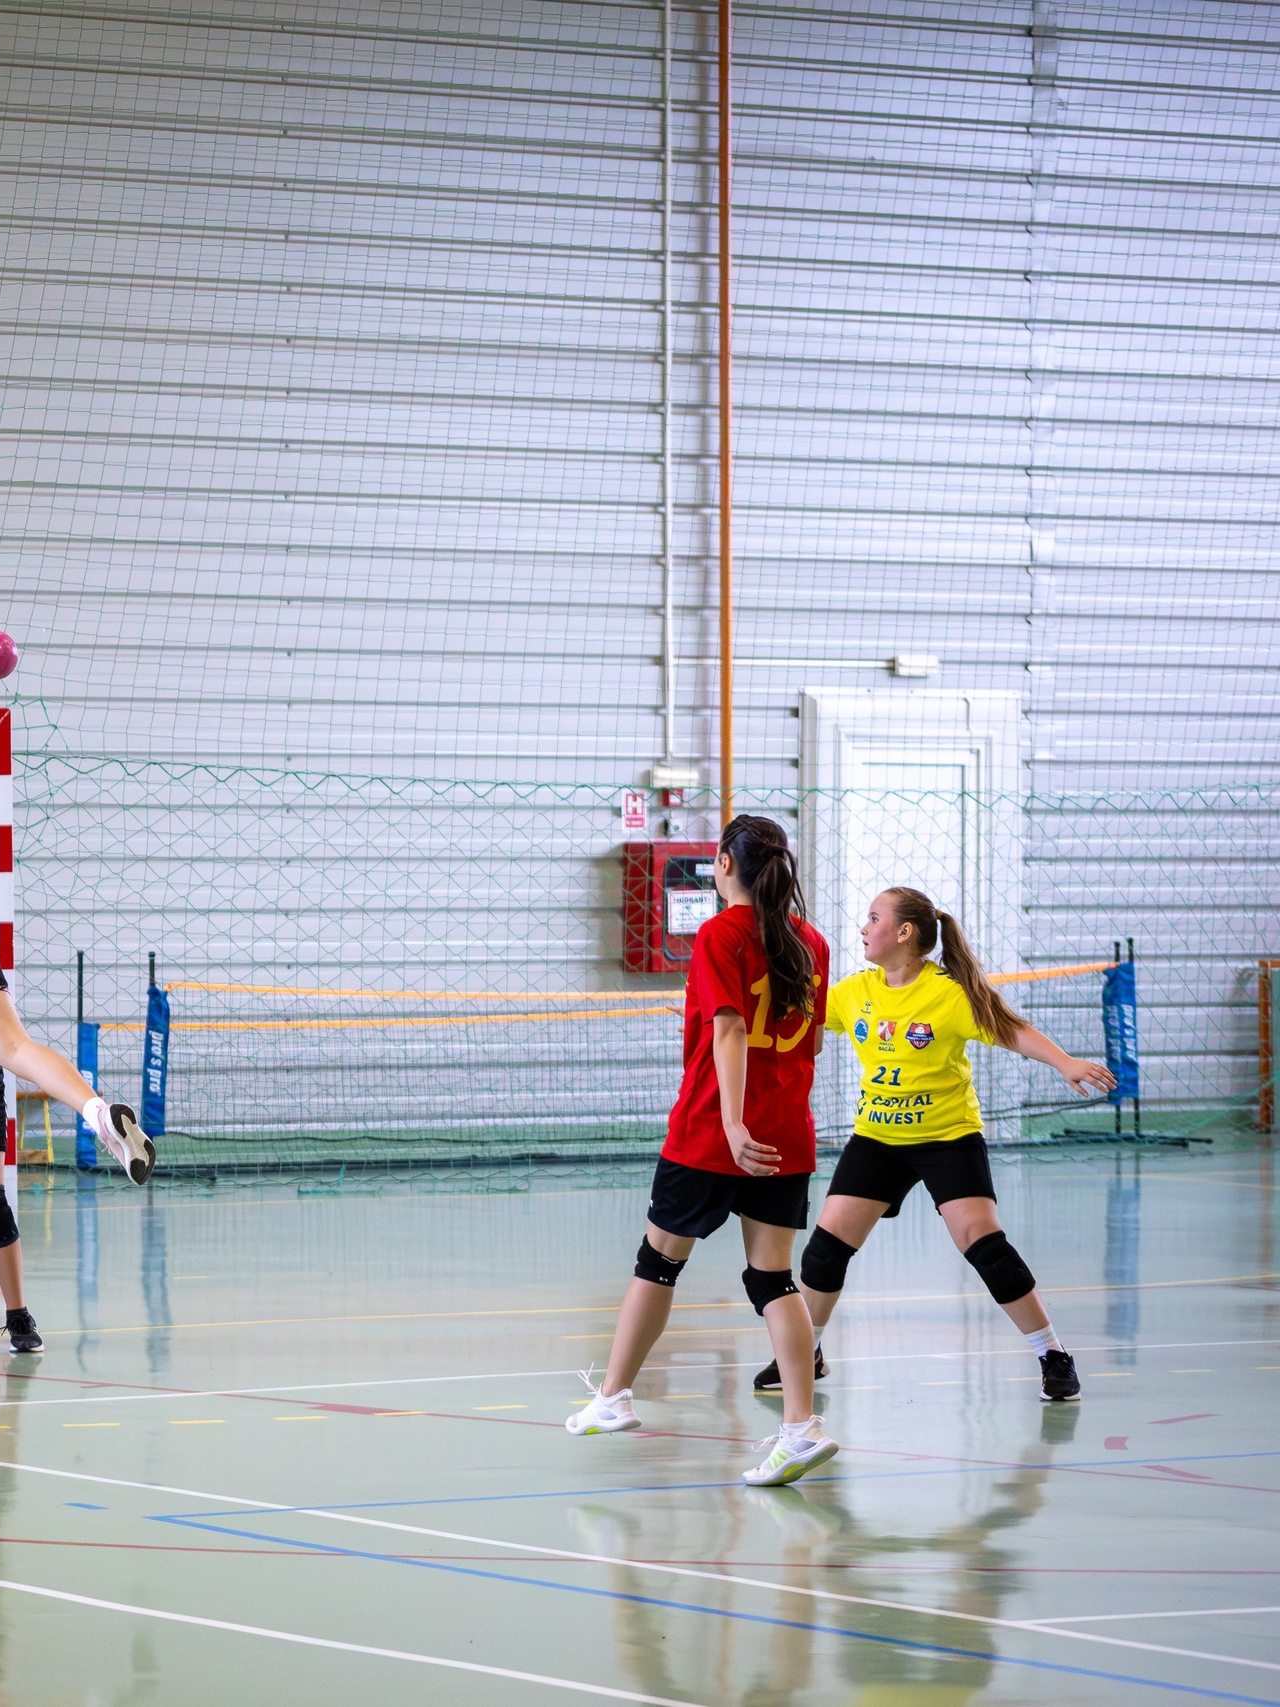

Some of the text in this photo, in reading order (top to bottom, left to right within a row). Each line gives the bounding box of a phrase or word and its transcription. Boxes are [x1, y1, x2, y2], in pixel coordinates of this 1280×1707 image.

[147, 1030, 165, 1092] pro's pro
[871, 1066, 901, 1086] 21
[868, 1110, 925, 1124] INVEST
